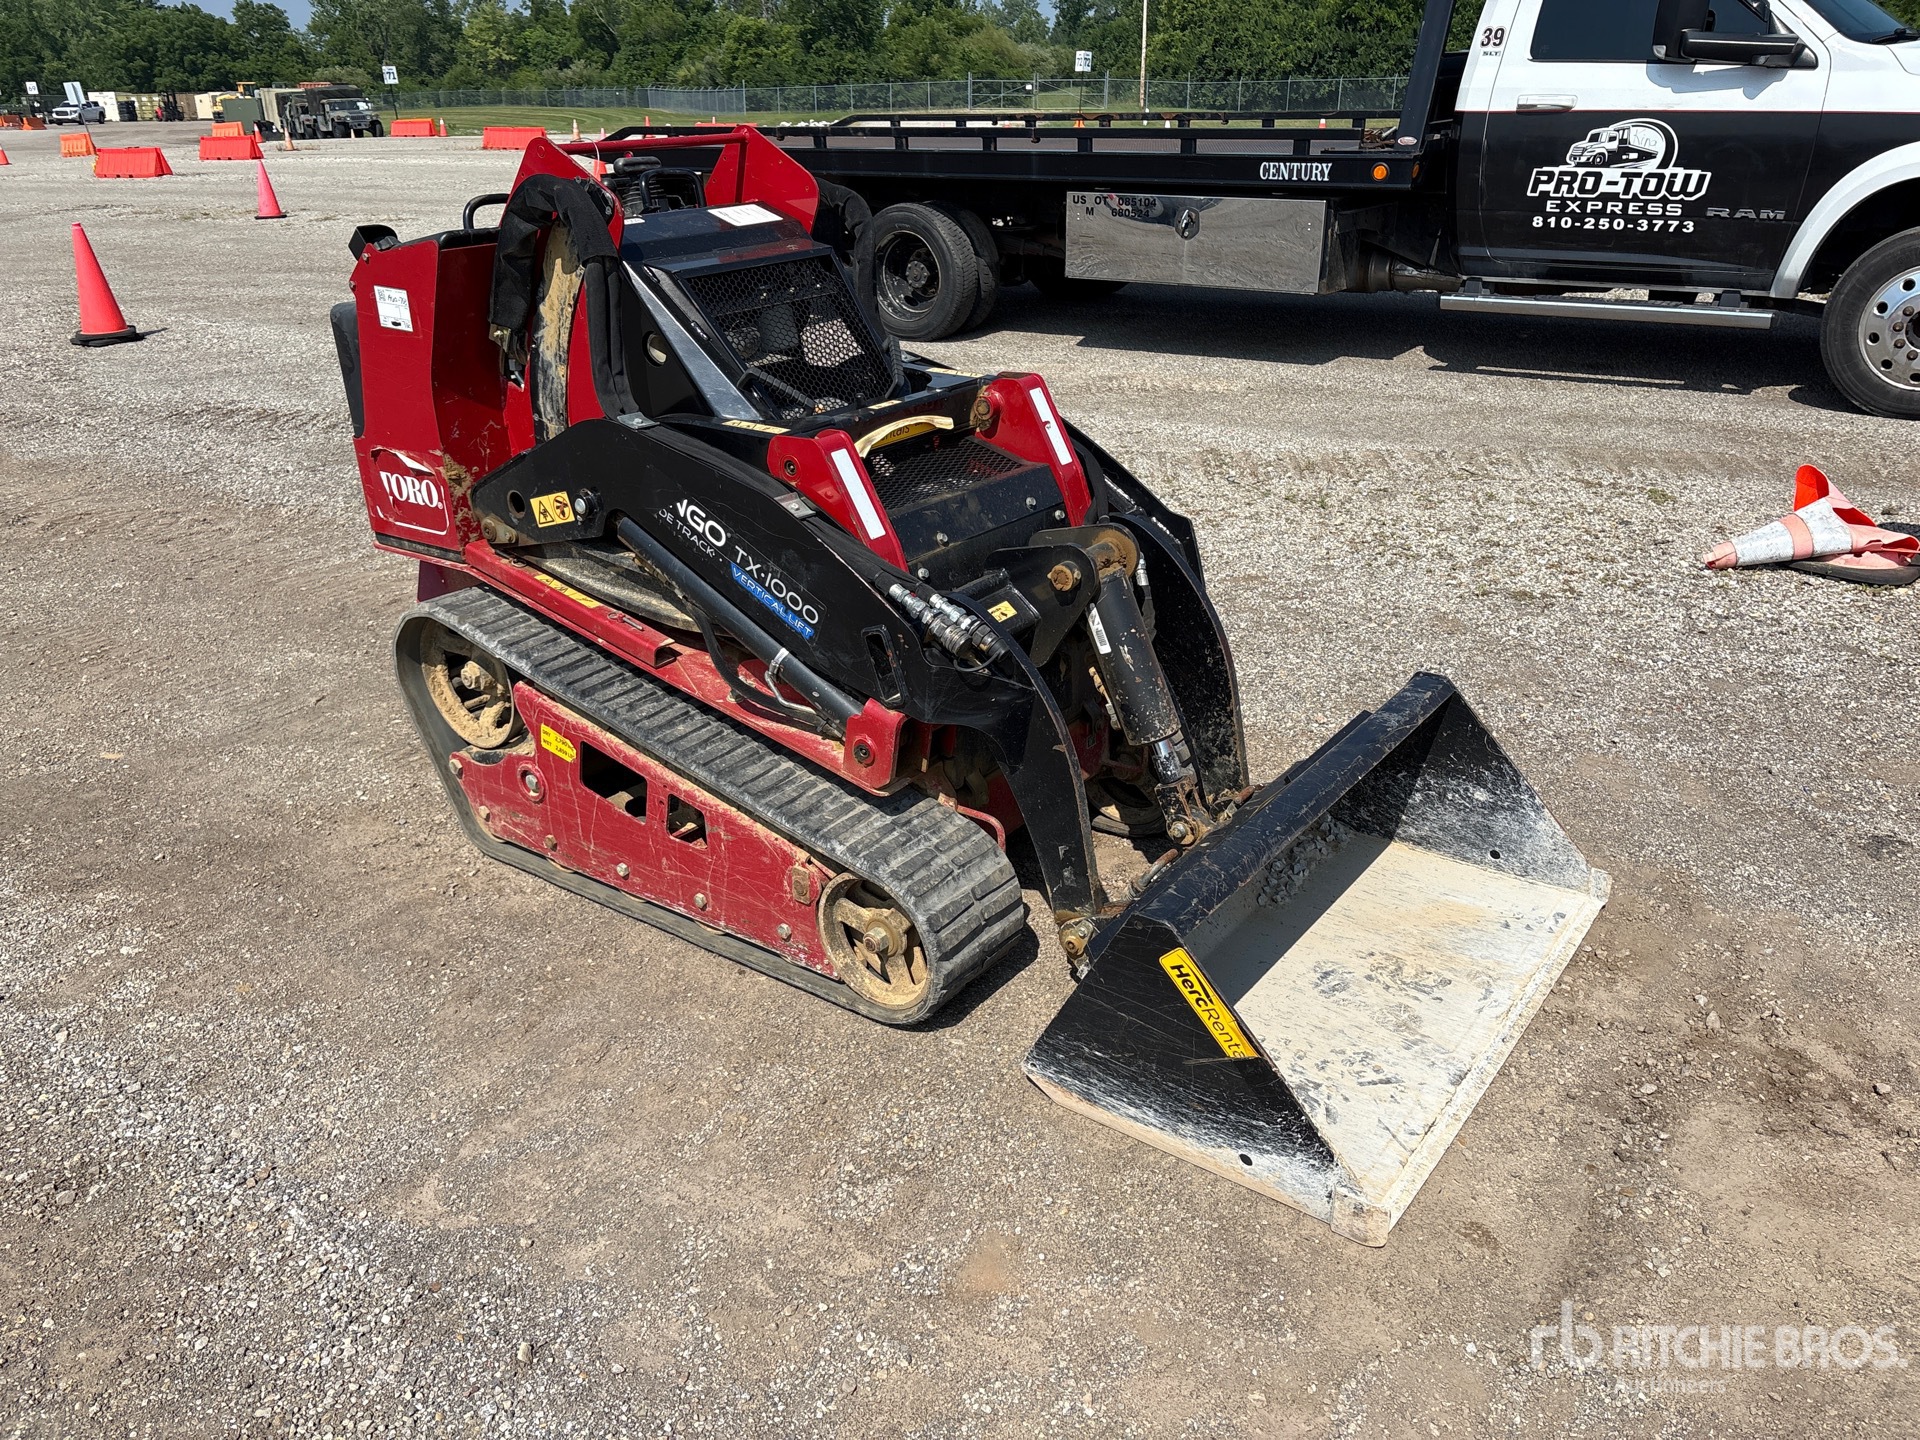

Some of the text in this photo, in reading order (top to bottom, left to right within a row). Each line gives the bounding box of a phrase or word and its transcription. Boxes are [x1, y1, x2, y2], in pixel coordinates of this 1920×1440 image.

[1481, 27, 1505, 47] 39
[386, 71, 397, 80] 71
[1259, 162, 1333, 181] CENTURY
[1528, 169, 1710, 200] PRO-TOW
[1072, 195, 1087, 205] US
[1117, 197, 1157, 208] 085104
[1545, 200, 1683, 216] EXPRESS
[1111, 208, 1150, 218] 680524
[1705, 206, 1786, 220] RAM
[1532, 216, 1695, 233] 810-250-3773
[733, 567, 812, 636] VERTICAL LIFT
